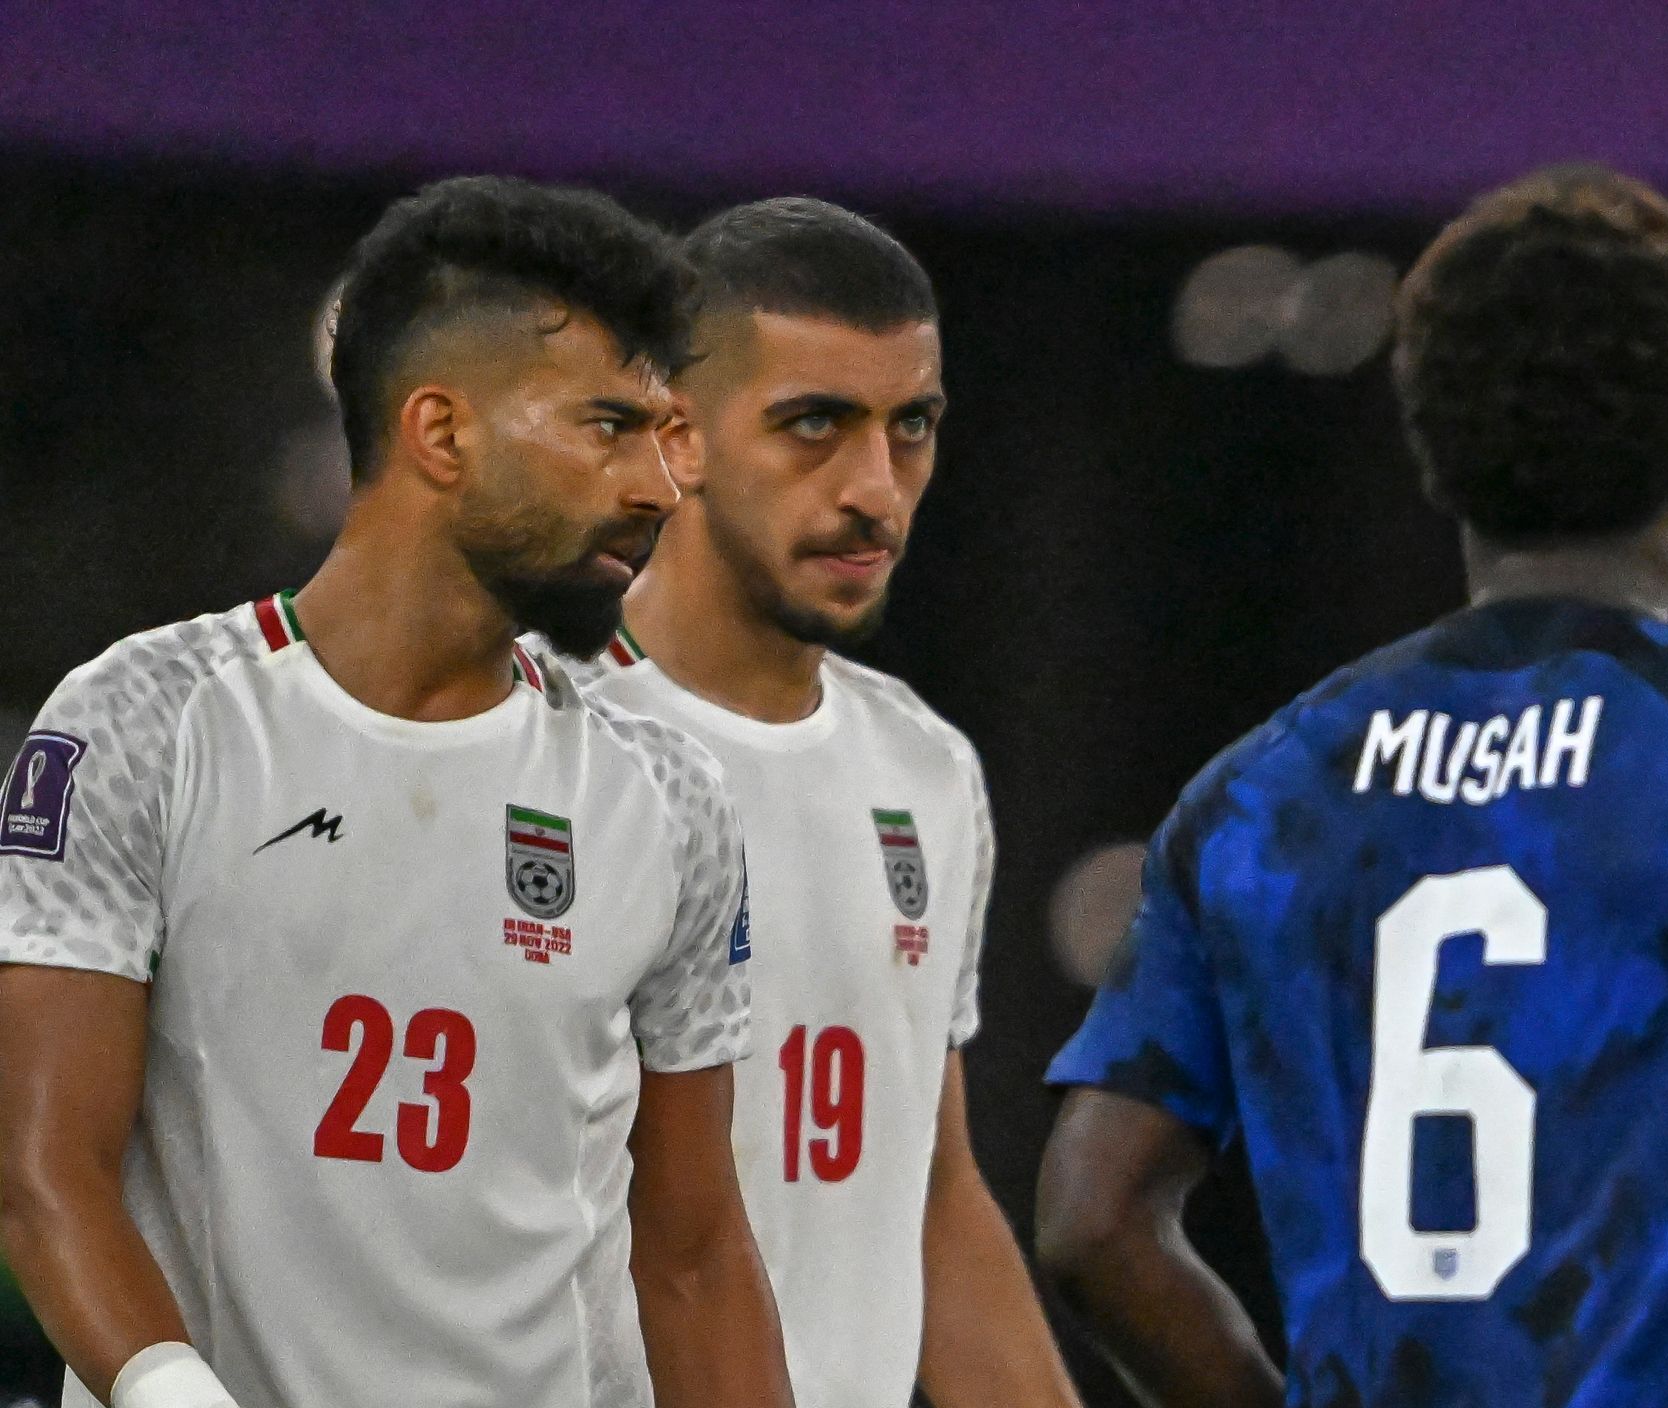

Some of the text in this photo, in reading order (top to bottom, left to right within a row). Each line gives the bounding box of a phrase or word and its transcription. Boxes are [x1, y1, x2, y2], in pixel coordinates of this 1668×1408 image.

[1353, 695, 1604, 804] MUSAH
[545, 938, 571, 955] 2022
[313, 994, 477, 1173] 23
[779, 1025, 866, 1183] 19
[1360, 864, 1549, 1301] 6
